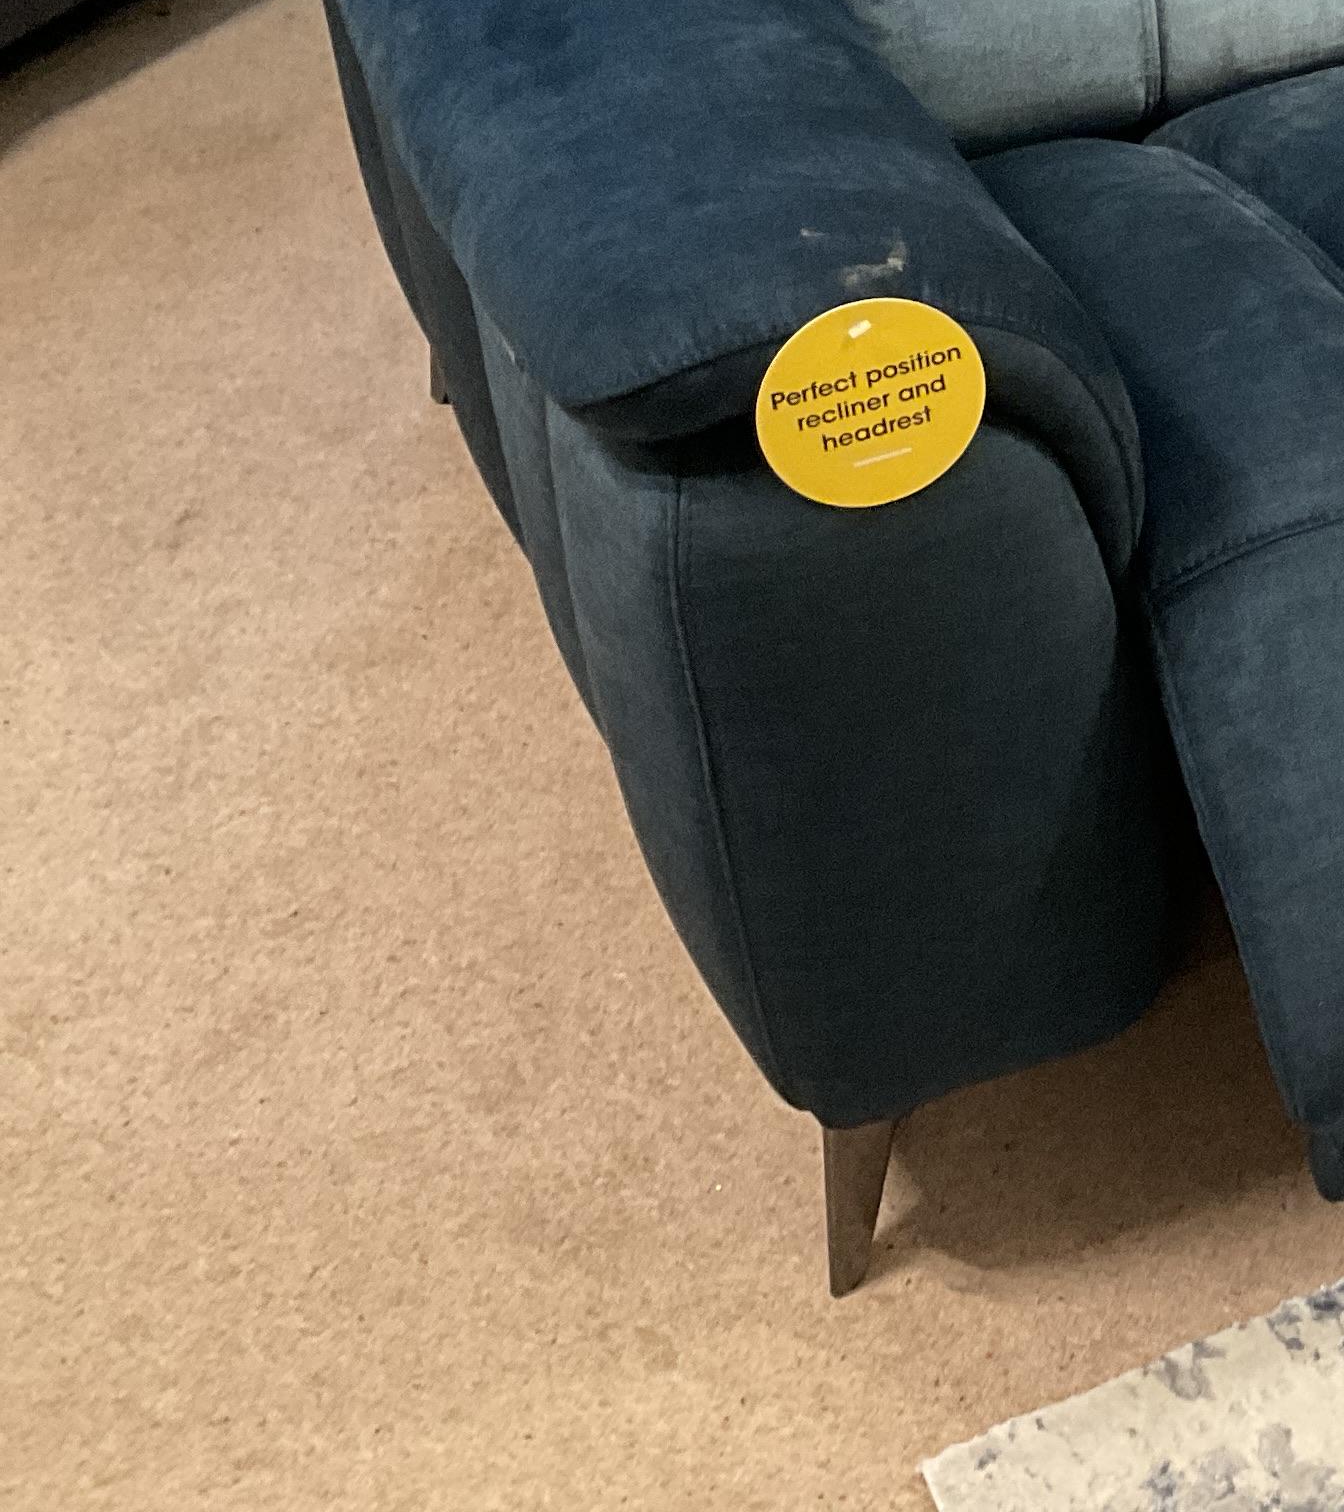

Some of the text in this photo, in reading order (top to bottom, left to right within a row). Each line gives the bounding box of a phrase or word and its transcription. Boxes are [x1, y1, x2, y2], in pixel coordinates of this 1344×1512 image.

[770, 346, 962, 410] Perfect position
[796, 374, 946, 431] recliner and
[822, 405, 932, 452] headrest
